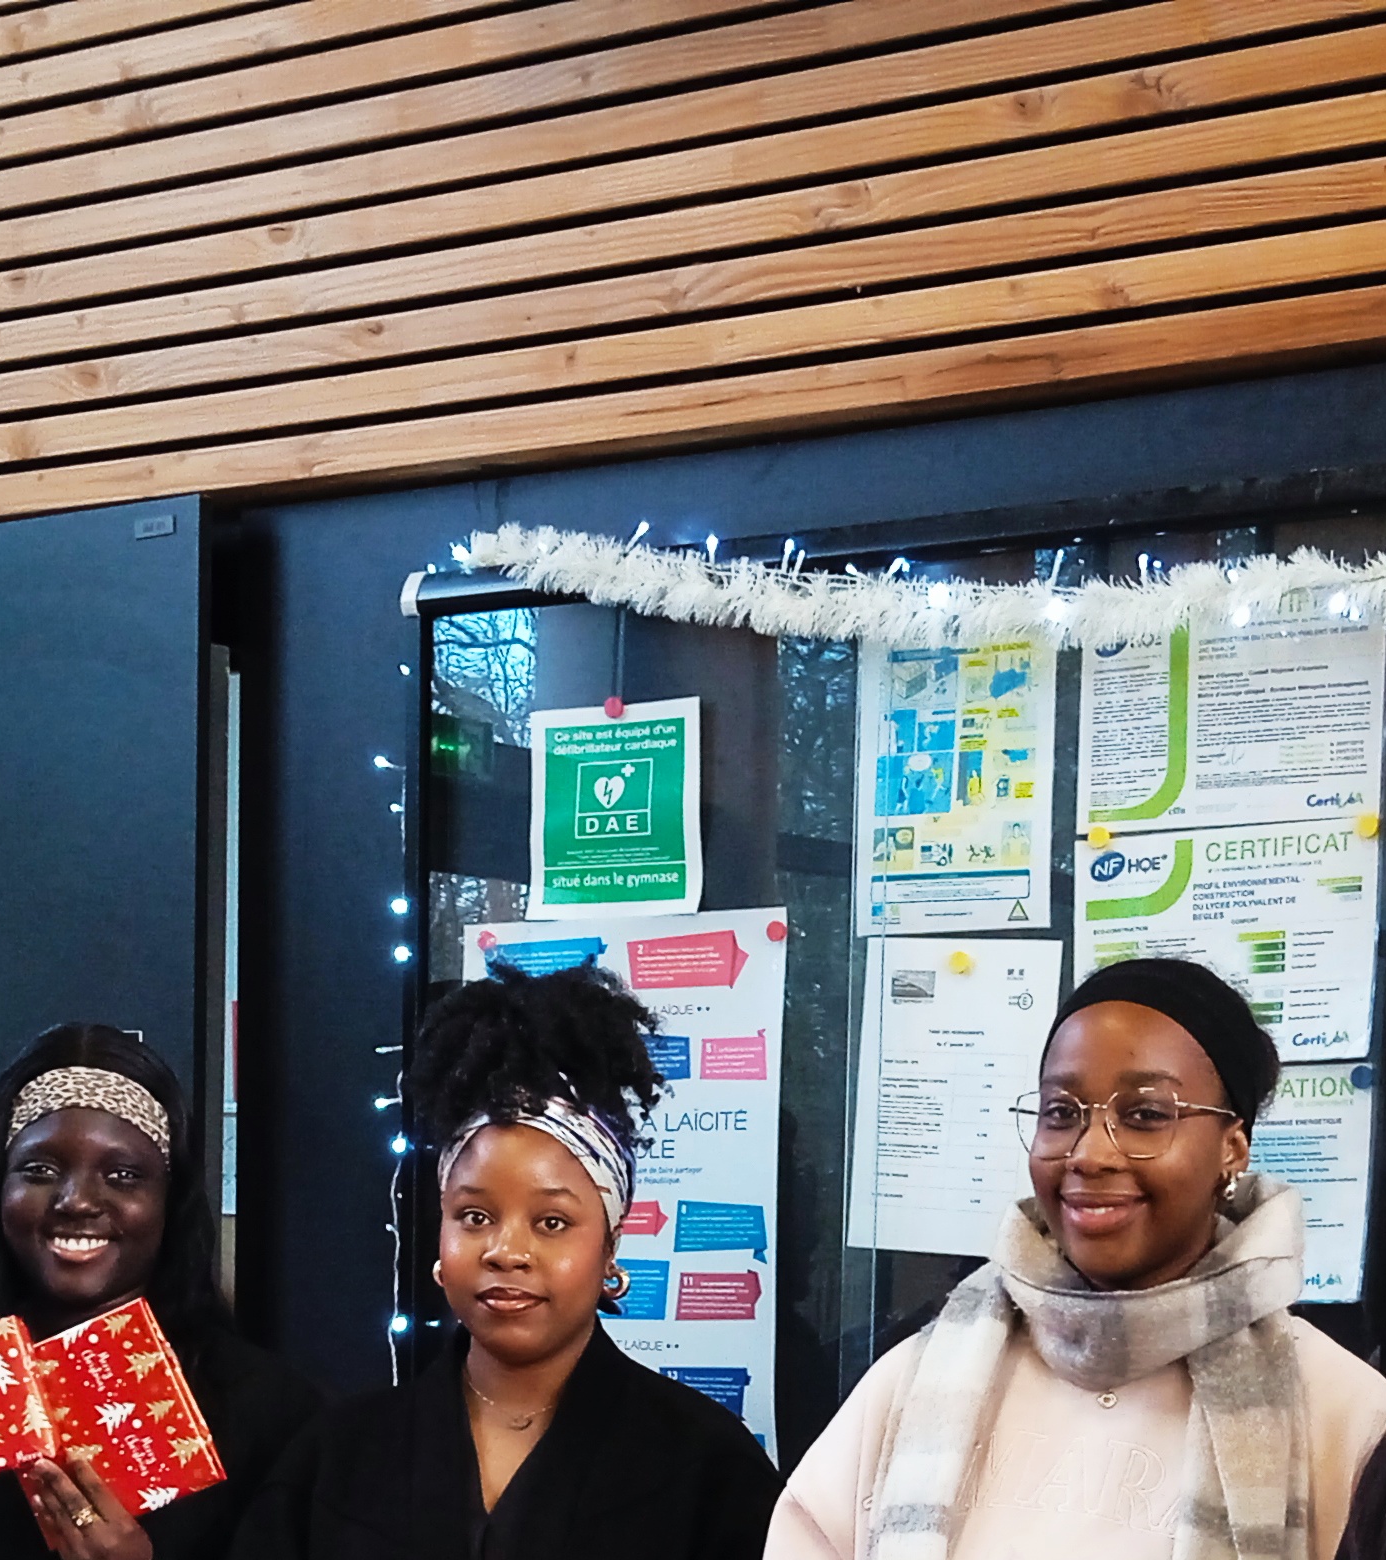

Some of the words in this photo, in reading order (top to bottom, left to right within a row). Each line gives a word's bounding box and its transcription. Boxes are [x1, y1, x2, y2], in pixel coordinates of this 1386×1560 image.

[554, 731, 571, 743] Ce
[573, 731, 593, 741] site
[596, 729, 612, 740] est
[615, 725, 650, 740] équipé
[653, 724, 677, 736] d'un
[625, 738, 678, 752] cardiaque
[1205, 831, 1354, 863] CERTIFICAT
[1094, 857, 1123, 877] NF
[552, 872, 580, 889] situé
[583, 872, 611, 887] dans
[613, 872, 625, 885] le
[627, 871, 679, 888] gymnase
[664, 1109, 748, 1132] LAÏCITÉ
